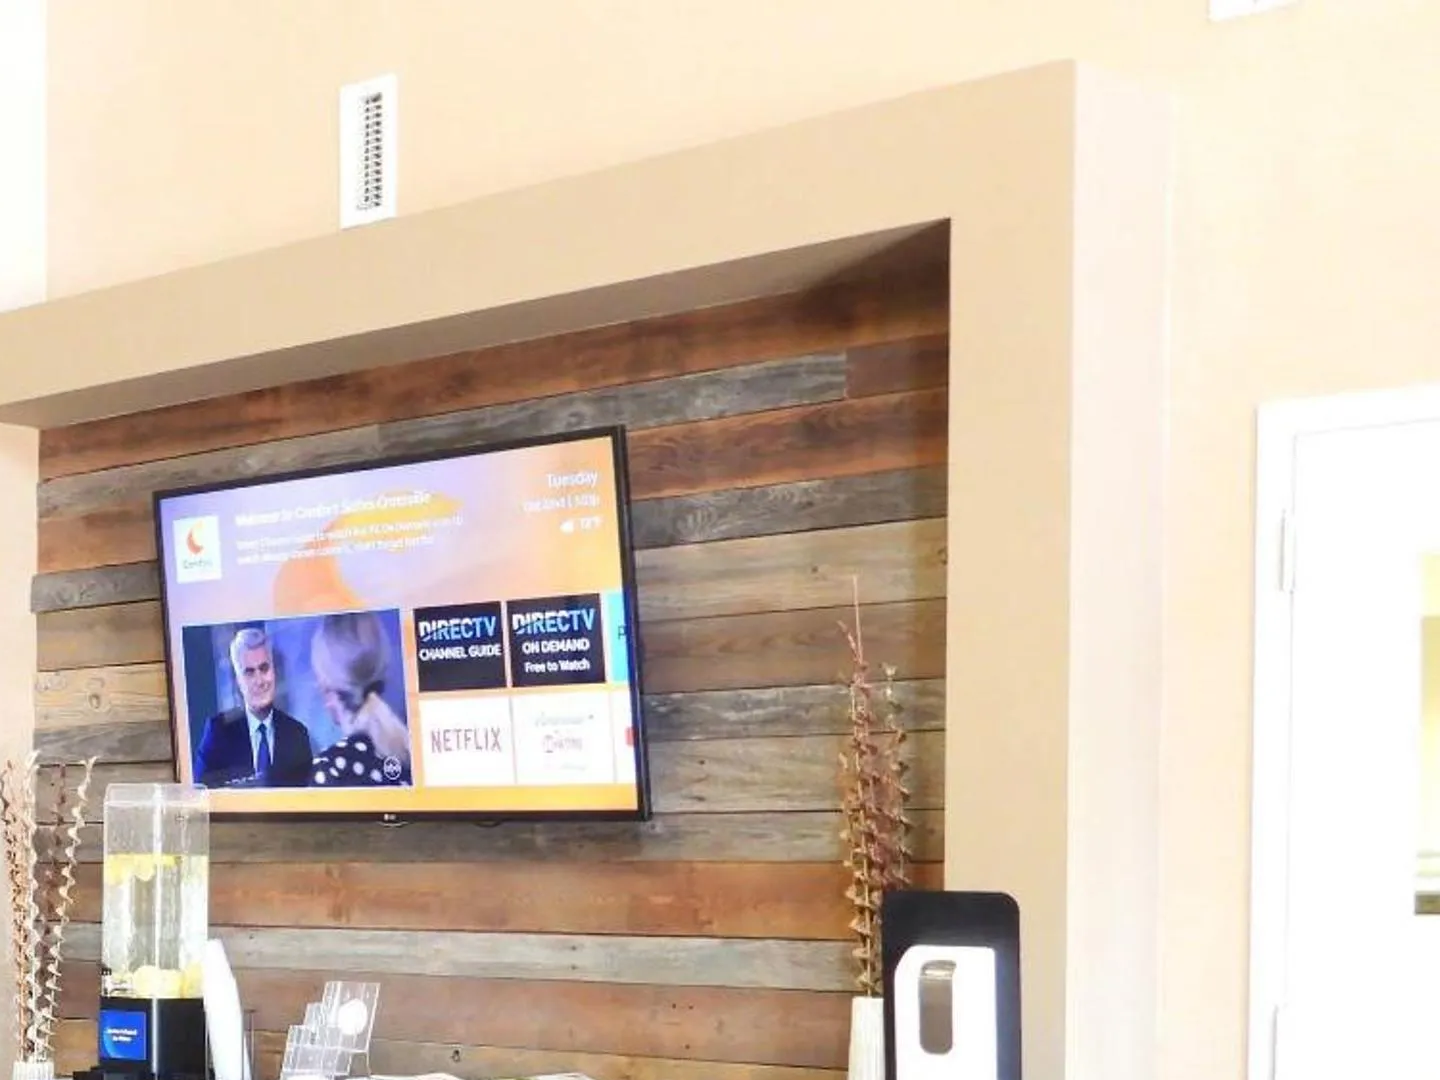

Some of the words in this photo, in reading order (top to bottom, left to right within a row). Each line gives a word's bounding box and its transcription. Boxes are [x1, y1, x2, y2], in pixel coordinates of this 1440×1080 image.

[546, 470, 598, 489] Tuesday
[419, 616, 496, 642] DIRECTV
[512, 608, 595, 634] DIRECTV
[420, 646, 467, 661] CHANNEL
[468, 643, 502, 658] GUIDE
[522, 641, 539, 654] ON
[541, 637, 590, 653] DEMAND
[524, 661, 545, 673] Free
[546, 661, 558, 671] to
[559, 657, 590, 671] Watch
[431, 727, 503, 753] NETFLIX
